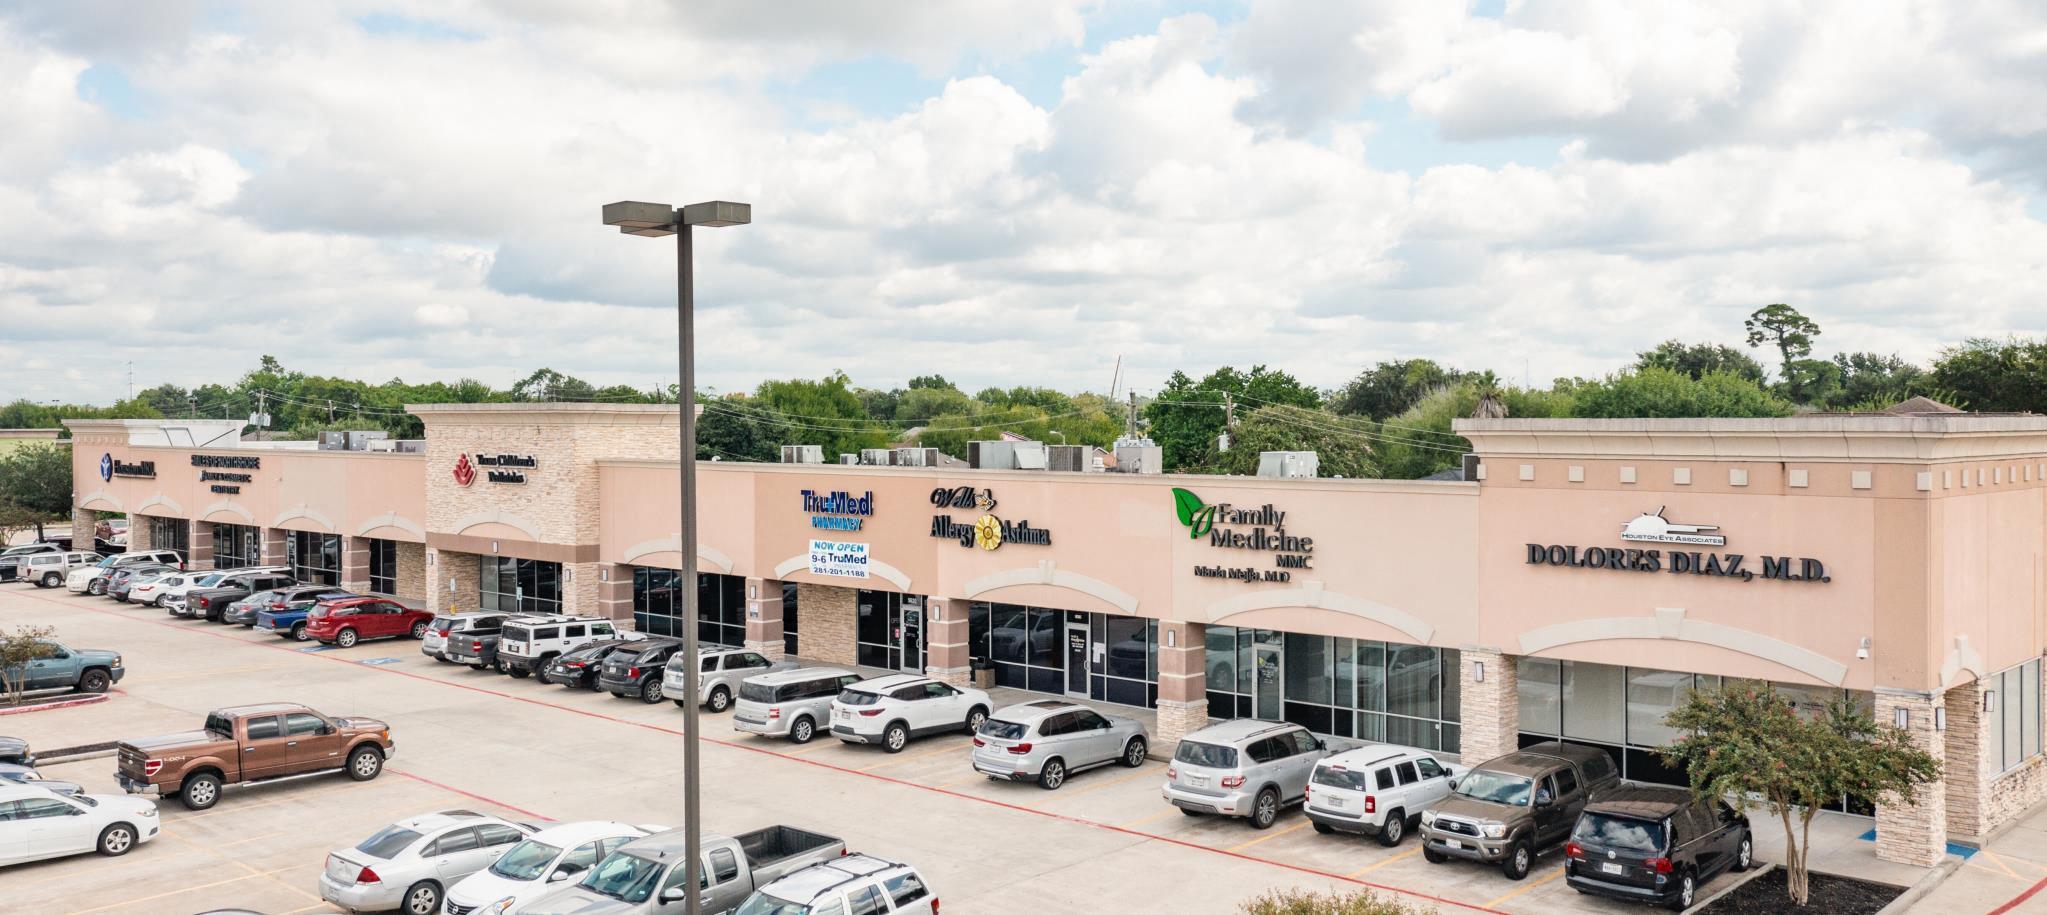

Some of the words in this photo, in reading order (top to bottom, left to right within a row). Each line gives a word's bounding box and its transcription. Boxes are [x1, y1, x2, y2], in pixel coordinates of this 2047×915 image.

[801, 489, 873, 516] TruMed
[930, 486, 977, 509] Wells
[812, 516, 863, 531] PHARMACY
[1218, 503, 1286, 533] Family
[930, 514, 976, 549] Allergy
[1001, 519, 1052, 546] Asthma
[1622, 533, 1658, 541] HOUSTON
[1675, 535, 1723, 545] ASSOCIATES
[815, 541, 835, 551] NOW
[837, 544, 864, 553] OPEN
[1210, 527, 1314, 554] Medicine
[811, 554, 827, 564] 9-6
[828, 552, 867, 565] TruMed
[1276, 554, 1313, 569] MMC
[1526, 543, 1663, 573] DOLORES
[1668, 551, 1753, 583] DIAZ,
[1760, 555, 1832, 584] M.D.
[814, 566, 865, 578] 281-201-1188
[1194, 565, 1227, 579] Maria
